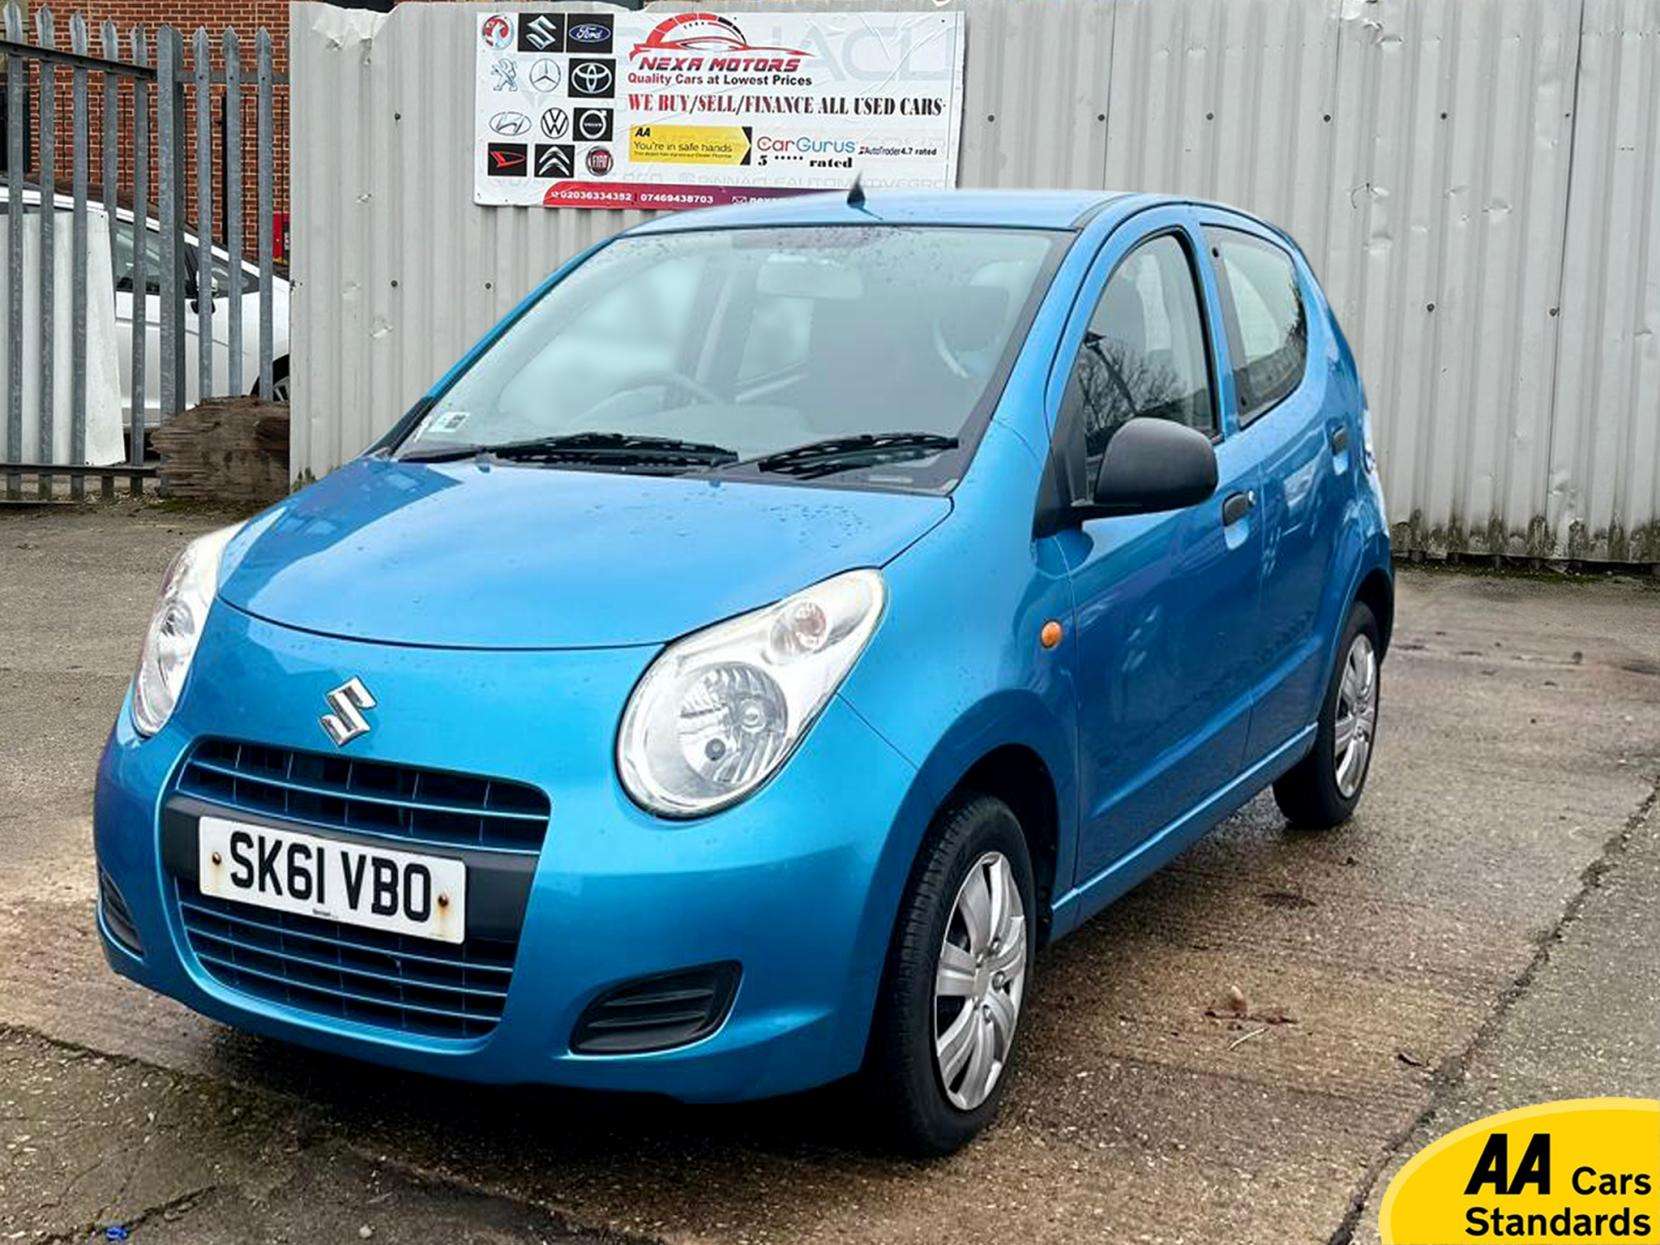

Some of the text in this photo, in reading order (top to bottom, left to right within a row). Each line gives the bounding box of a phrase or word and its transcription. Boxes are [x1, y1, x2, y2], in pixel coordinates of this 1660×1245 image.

[639, 56, 801, 72] NEXA MOTORS
[627, 73, 813, 86] Quality Cars at Lowest Prices
[628, 94, 943, 116] WE BUY/SELL/FINANCE ALL USED CARS
[635, 127, 651, 137] AA
[633, 141, 733, 153] You're in safe hands
[757, 136, 855, 153] CarGurus
[915, 147, 937, 155] rated
[757, 155, 853, 168] 5 rated
[230, 831, 432, 923] SK61 VBO
